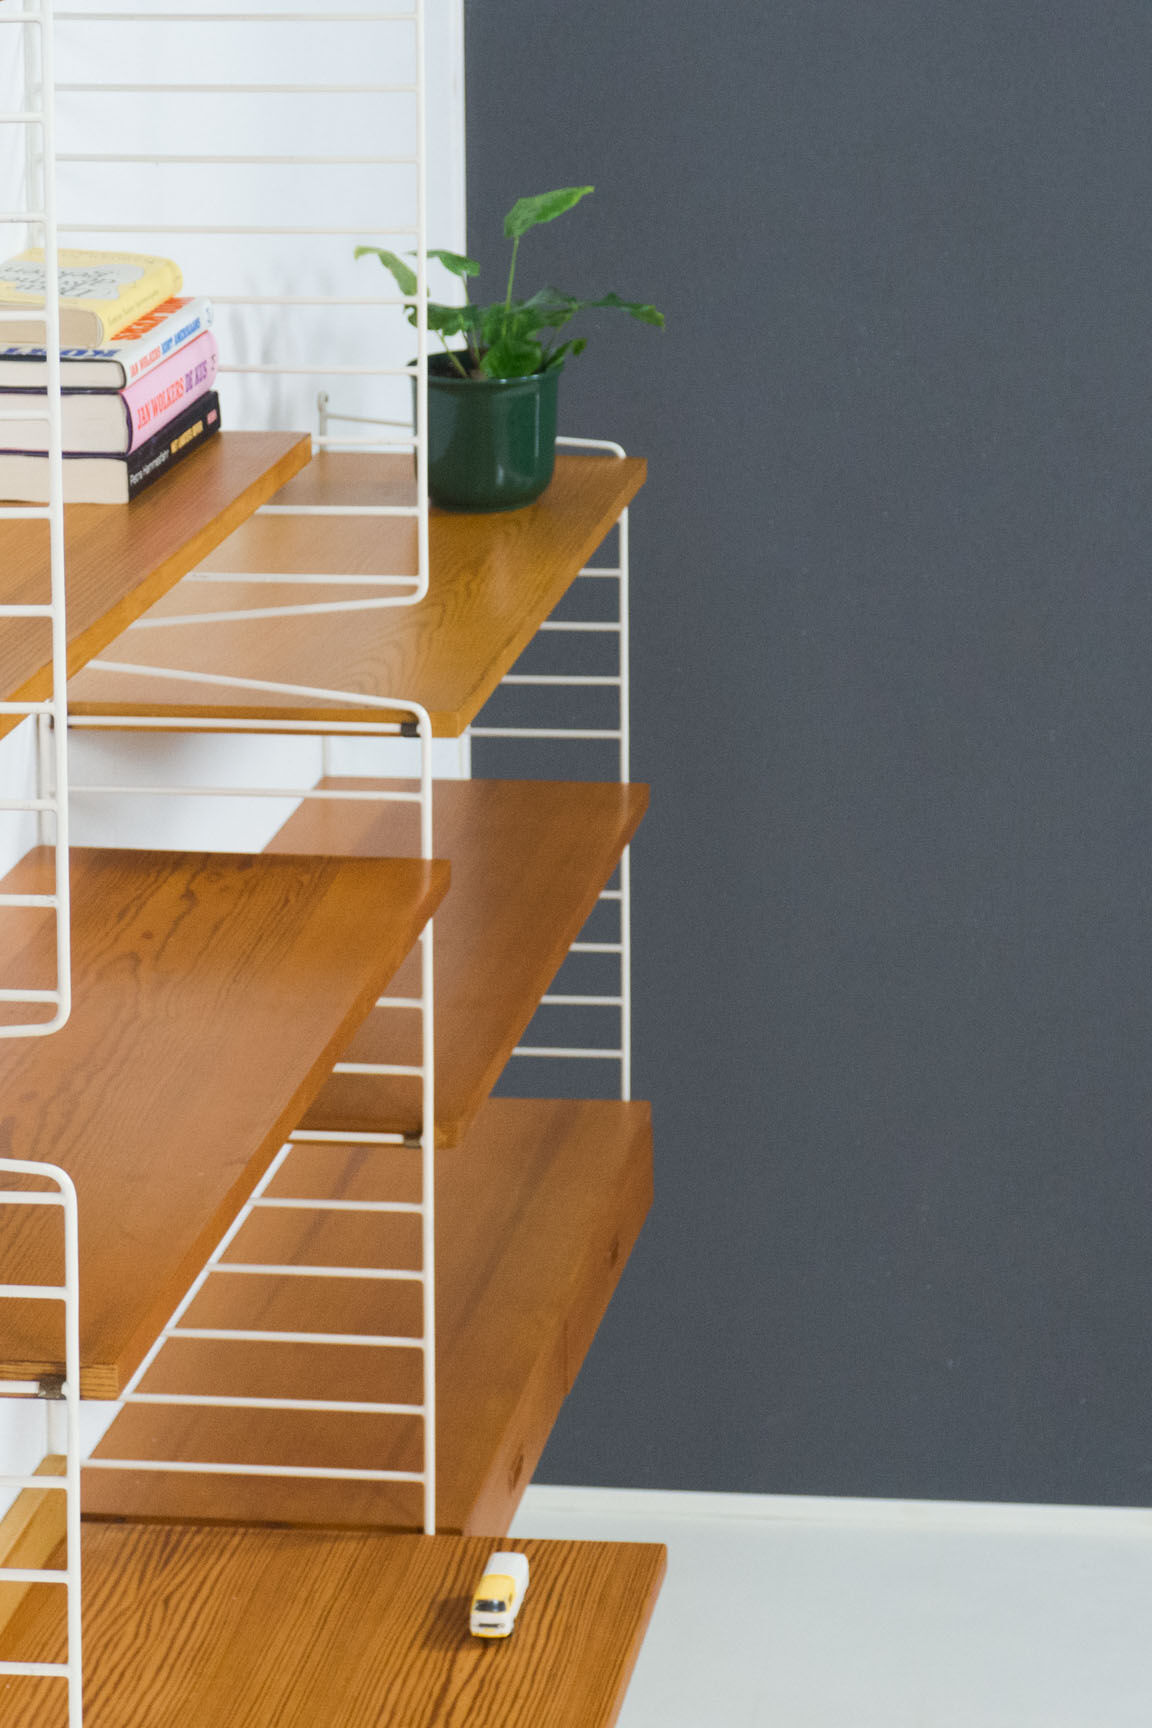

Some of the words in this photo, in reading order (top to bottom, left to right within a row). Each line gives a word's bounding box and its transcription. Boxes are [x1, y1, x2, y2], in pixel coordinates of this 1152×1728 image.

[136, 403, 151, 431] JAN
[151, 376, 184, 418] WOLKERS
[185, 369, 194, 393] DE
[194, 359, 208, 387] KUS
